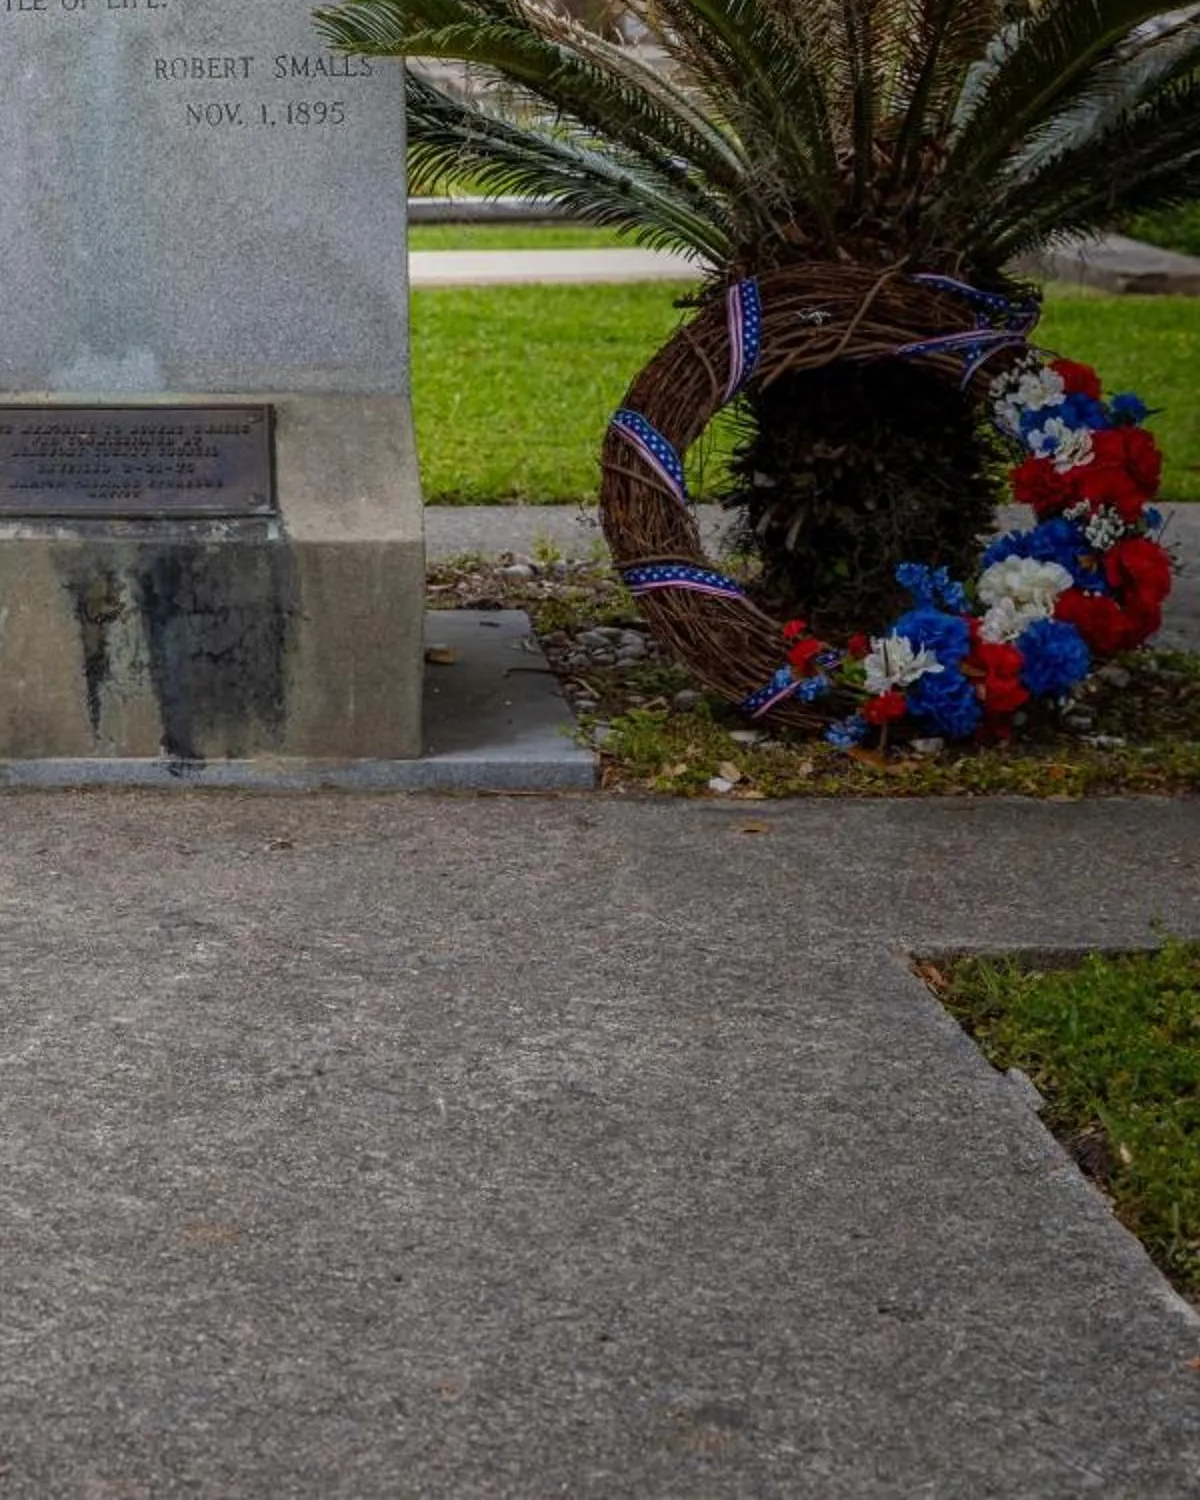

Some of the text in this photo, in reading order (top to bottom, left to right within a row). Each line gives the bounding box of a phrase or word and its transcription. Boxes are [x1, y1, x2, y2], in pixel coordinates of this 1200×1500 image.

[154, 54, 374, 81] ROBERT SMALLS
[187, 103, 244, 127] NOV.
[286, 101, 346, 126] 1895
